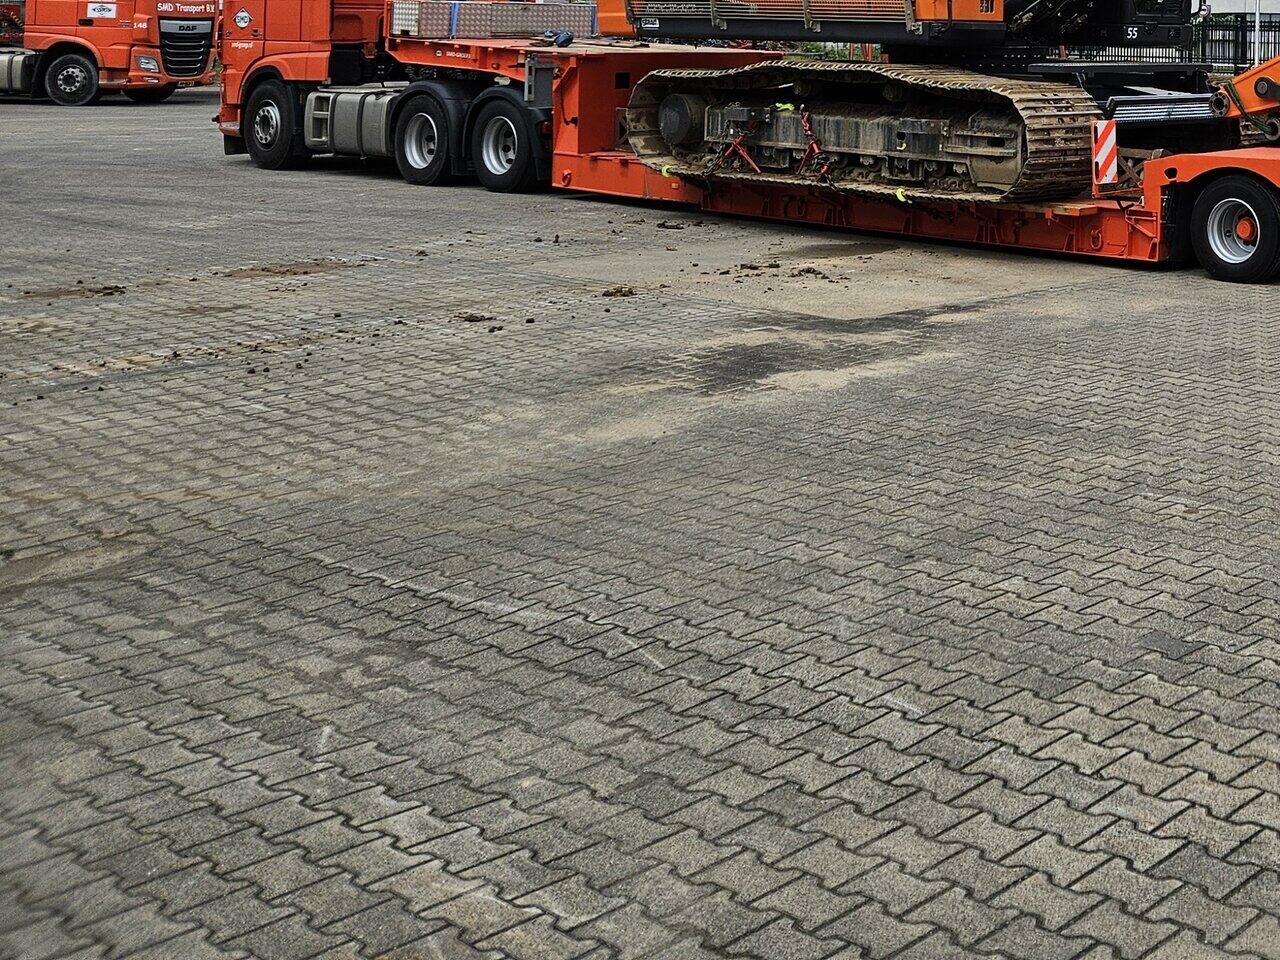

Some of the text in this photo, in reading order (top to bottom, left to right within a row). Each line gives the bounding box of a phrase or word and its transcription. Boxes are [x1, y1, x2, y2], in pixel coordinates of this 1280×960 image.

[157, 3, 174, 11] SMD
[175, 3, 205, 14] Transport
[1127, 27, 1138, 39] 55
